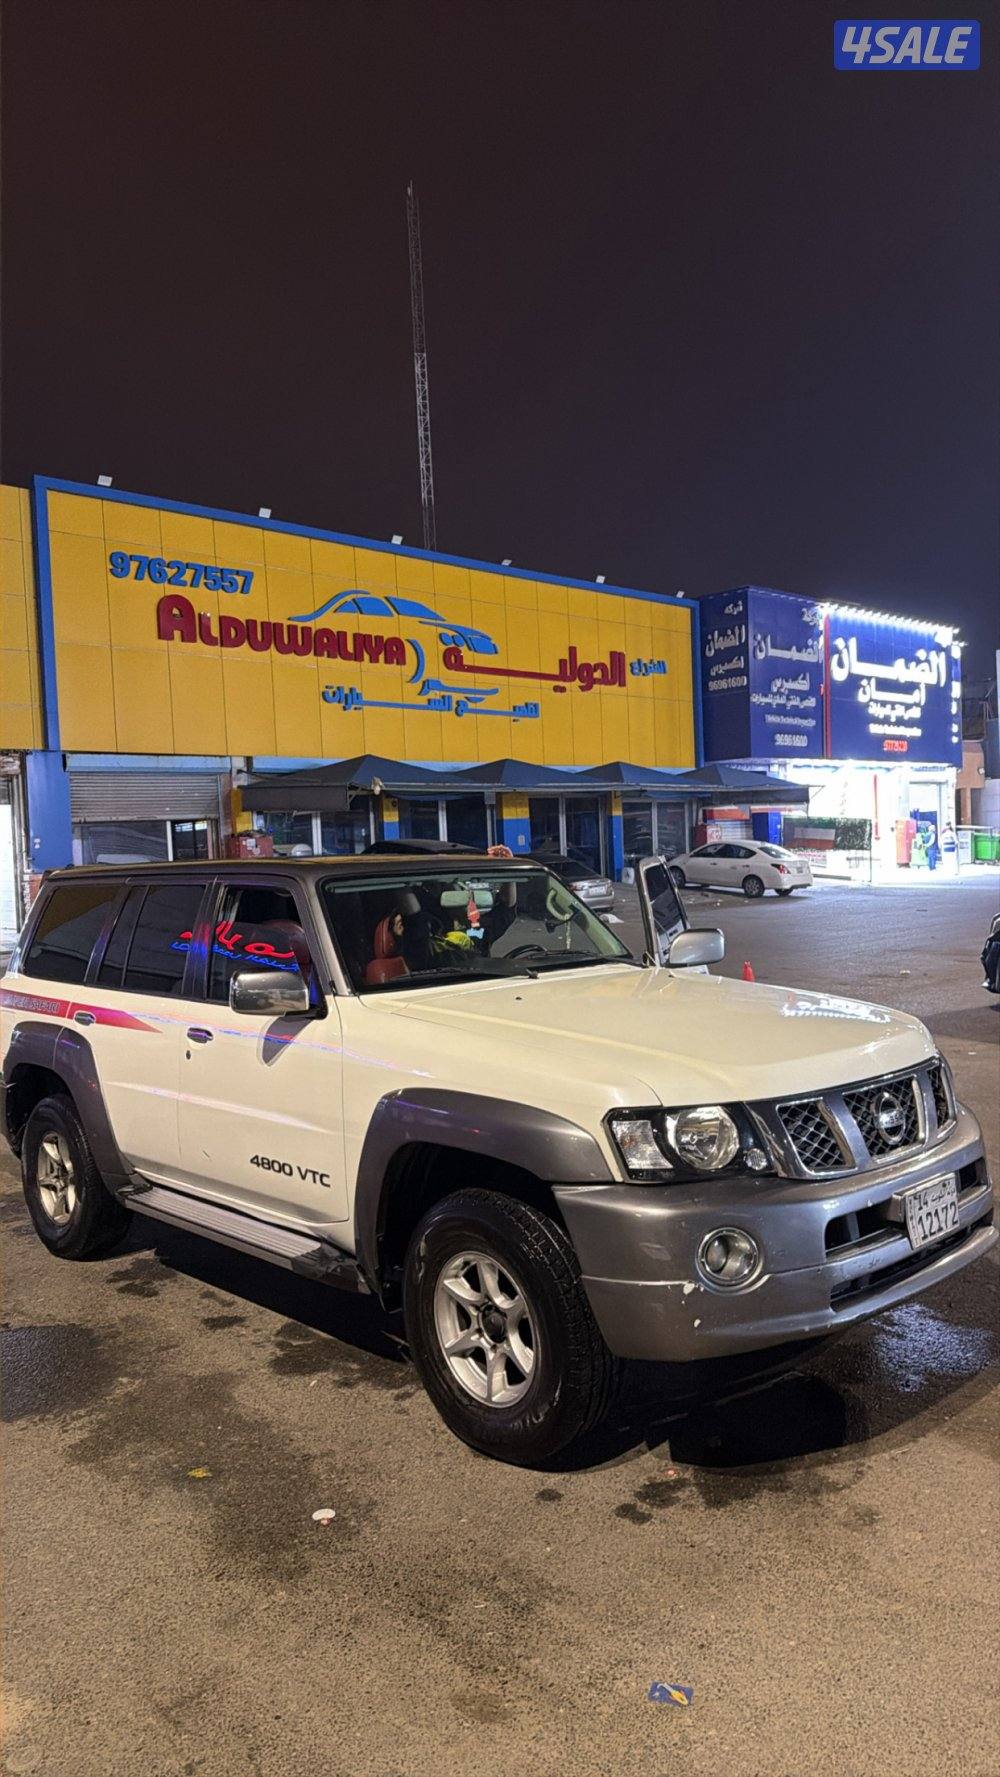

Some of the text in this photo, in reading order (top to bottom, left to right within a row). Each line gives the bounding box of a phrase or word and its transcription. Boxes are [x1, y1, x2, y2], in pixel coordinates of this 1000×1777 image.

[109, 551, 254, 594] 97627557
[705, 625, 746, 657] الضمان
[831, 636, 947, 687] الضمان
[439, 632, 627, 693] الدولية
[249, 1154, 331, 1188] 4800 VTC
[917, 1201, 959, 1240] 12172
